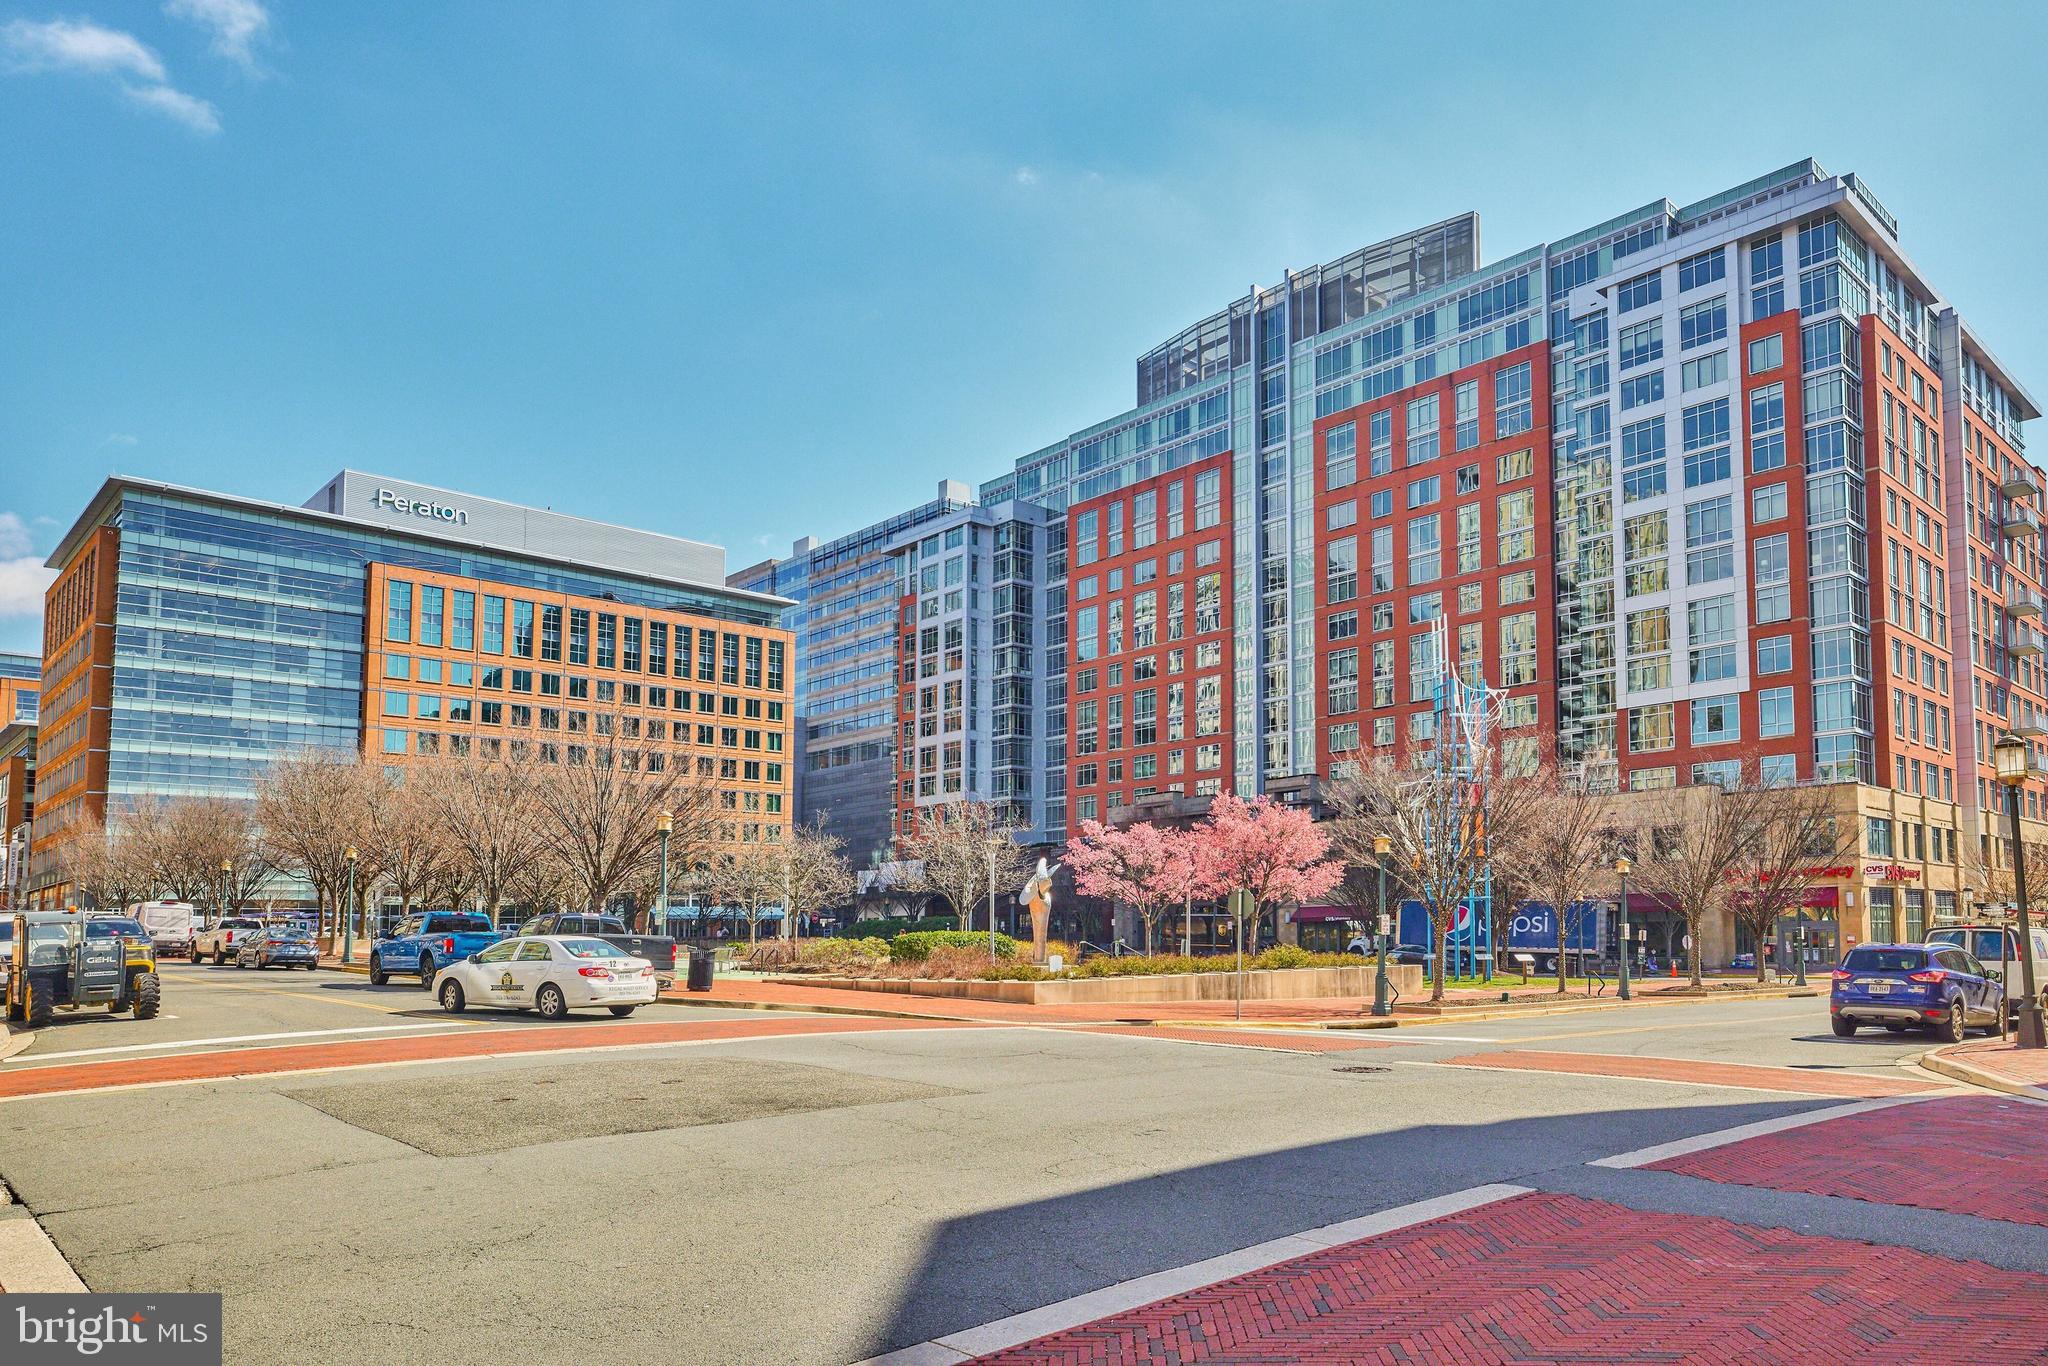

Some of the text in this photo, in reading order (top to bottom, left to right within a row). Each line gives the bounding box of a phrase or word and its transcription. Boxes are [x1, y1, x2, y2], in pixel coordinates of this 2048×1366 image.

[378, 488, 469, 524] Peraton
[1865, 865, 1884, 873] CVS
[1477, 911, 1549, 938] ppsi
[86, 956, 117, 964] GEHL
[609, 960, 617, 968] 12
